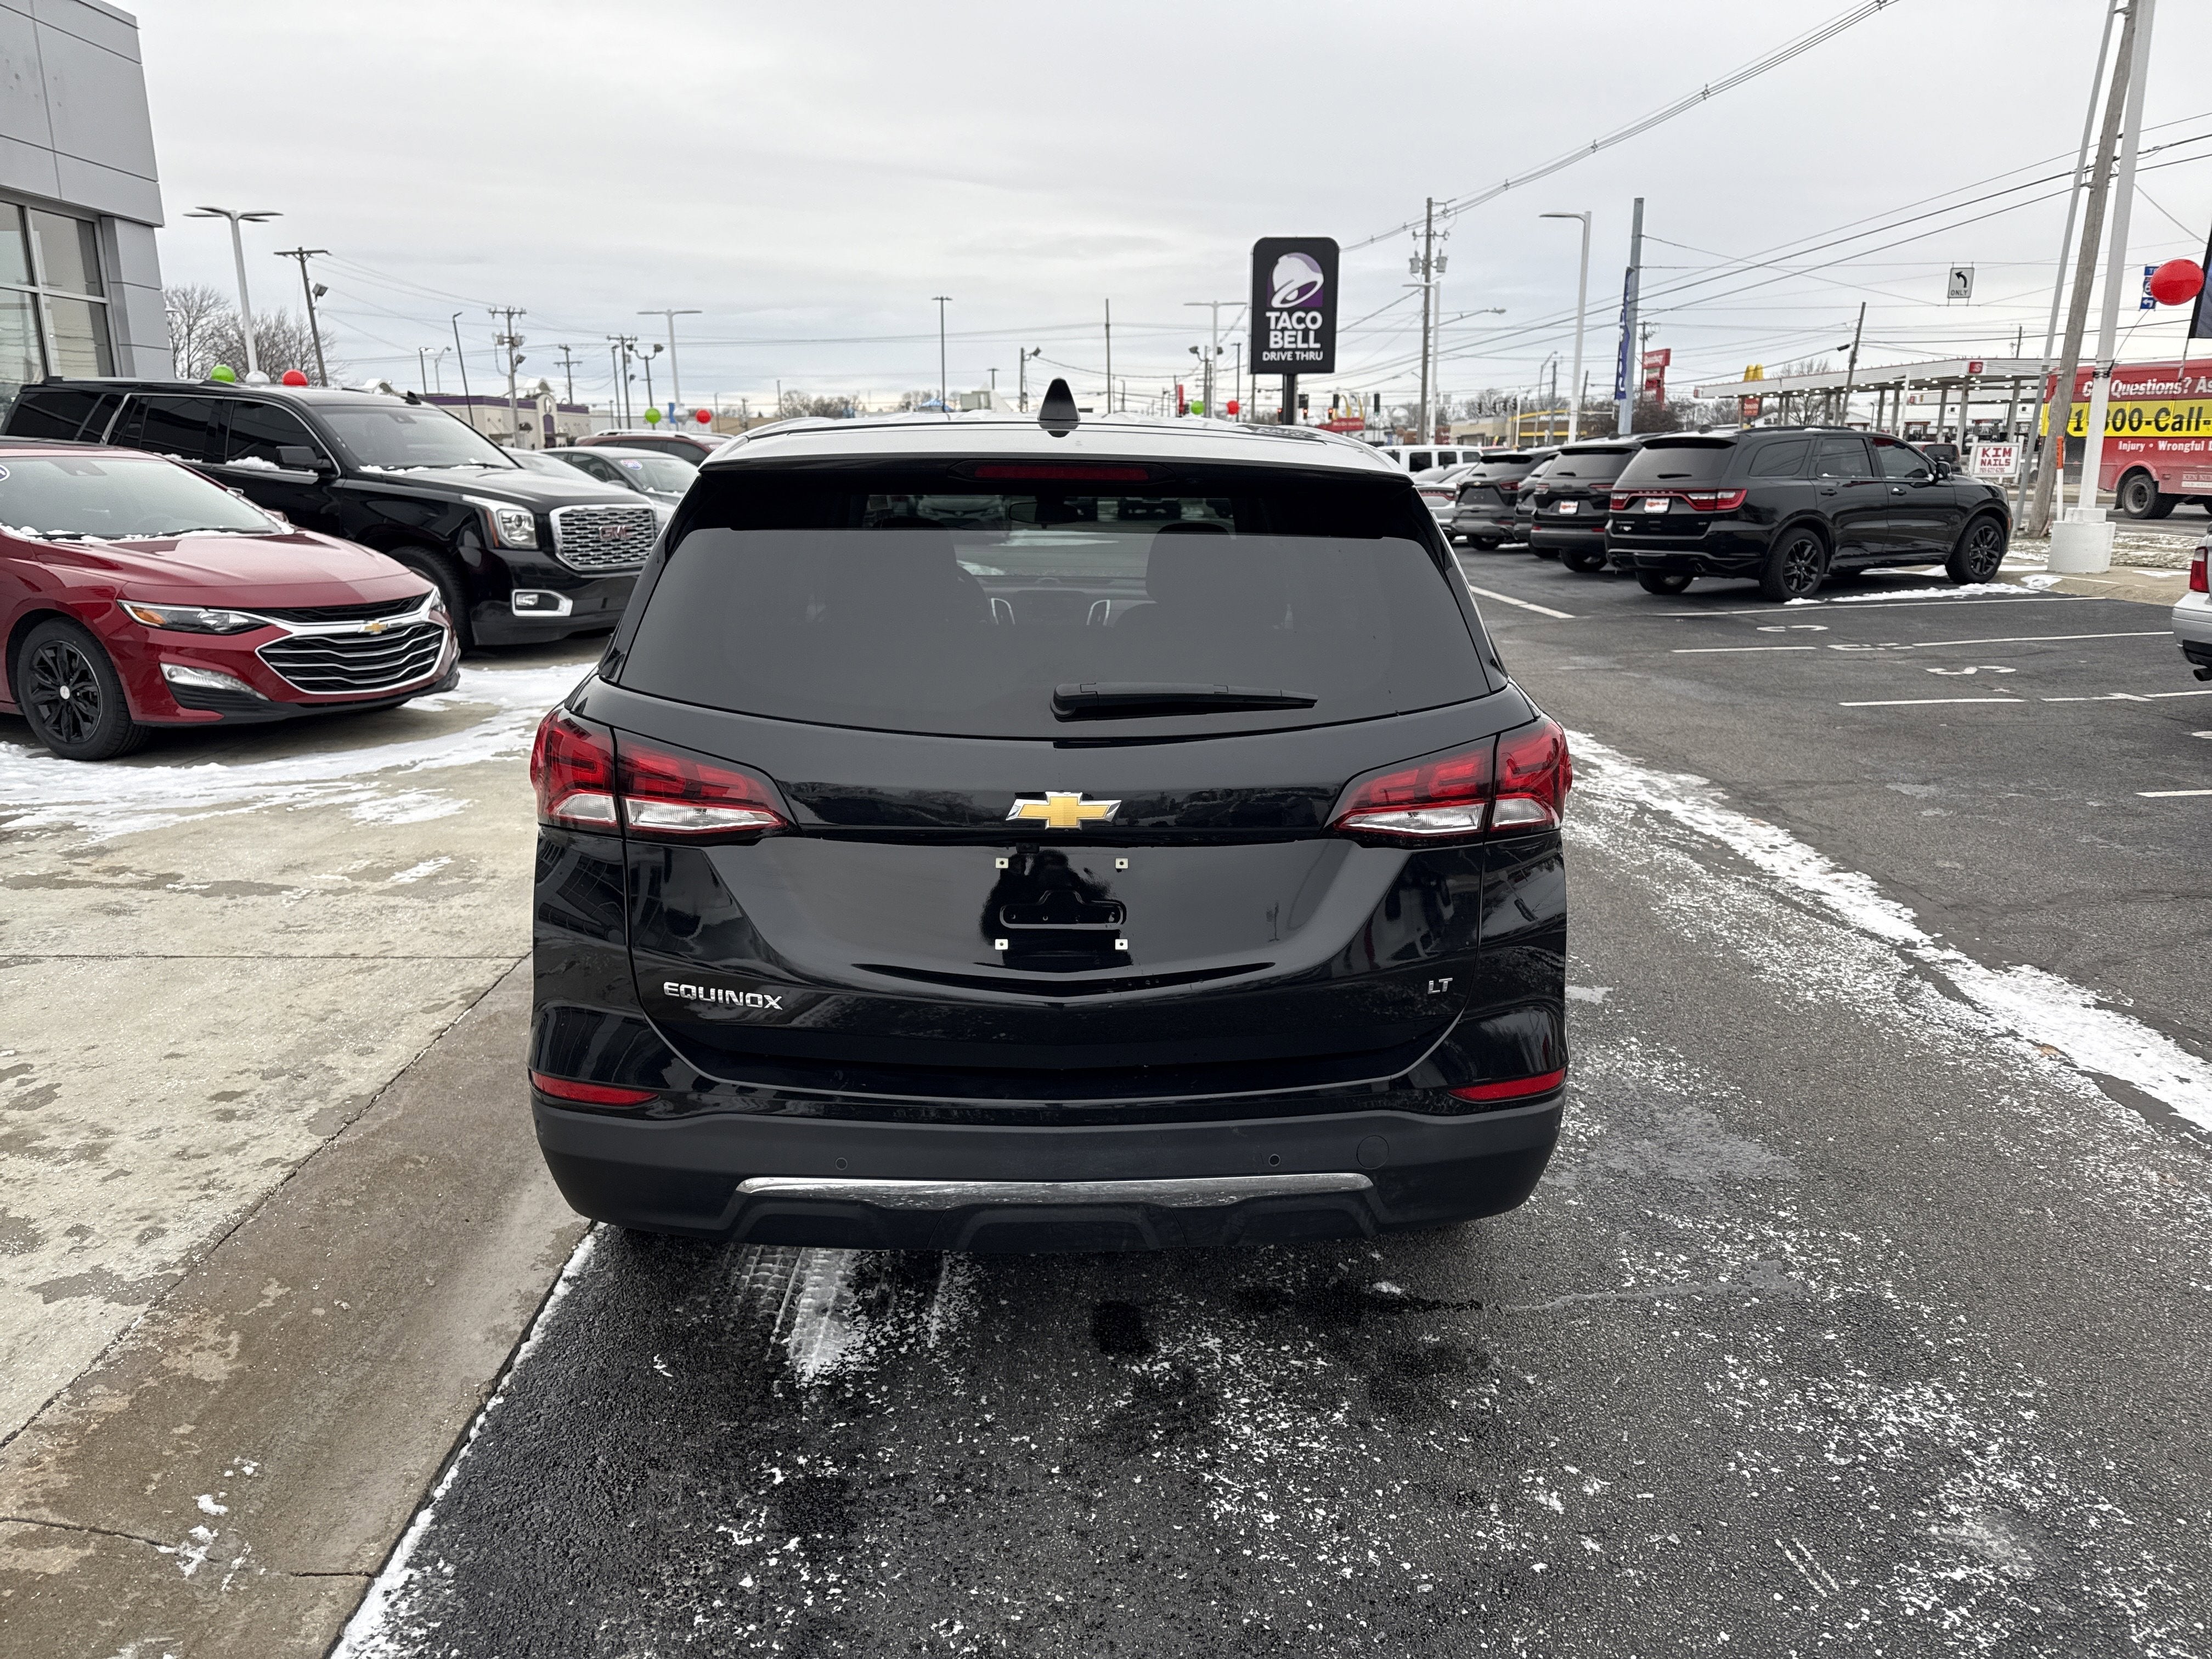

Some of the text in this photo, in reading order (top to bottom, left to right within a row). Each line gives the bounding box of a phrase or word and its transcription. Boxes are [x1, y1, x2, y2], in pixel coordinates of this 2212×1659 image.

[1265, 311, 1323, 330] TACO
[1269, 330, 1321, 349] BELL
[1262, 351, 1323, 361] DRIVE THRU
[2111, 377, 2192, 398] Questions?
[2073, 406, 2211, 432] 100-Call-
[1982, 448, 2012, 457] KIM
[2118, 441, 2146, 452] Injury
[2158, 440, 2205, 452] Wrongful
[599, 525, 634, 540] GMC
[1427, 978, 1453, 994] LT
[664, 982, 783, 1011] EQUINOX
